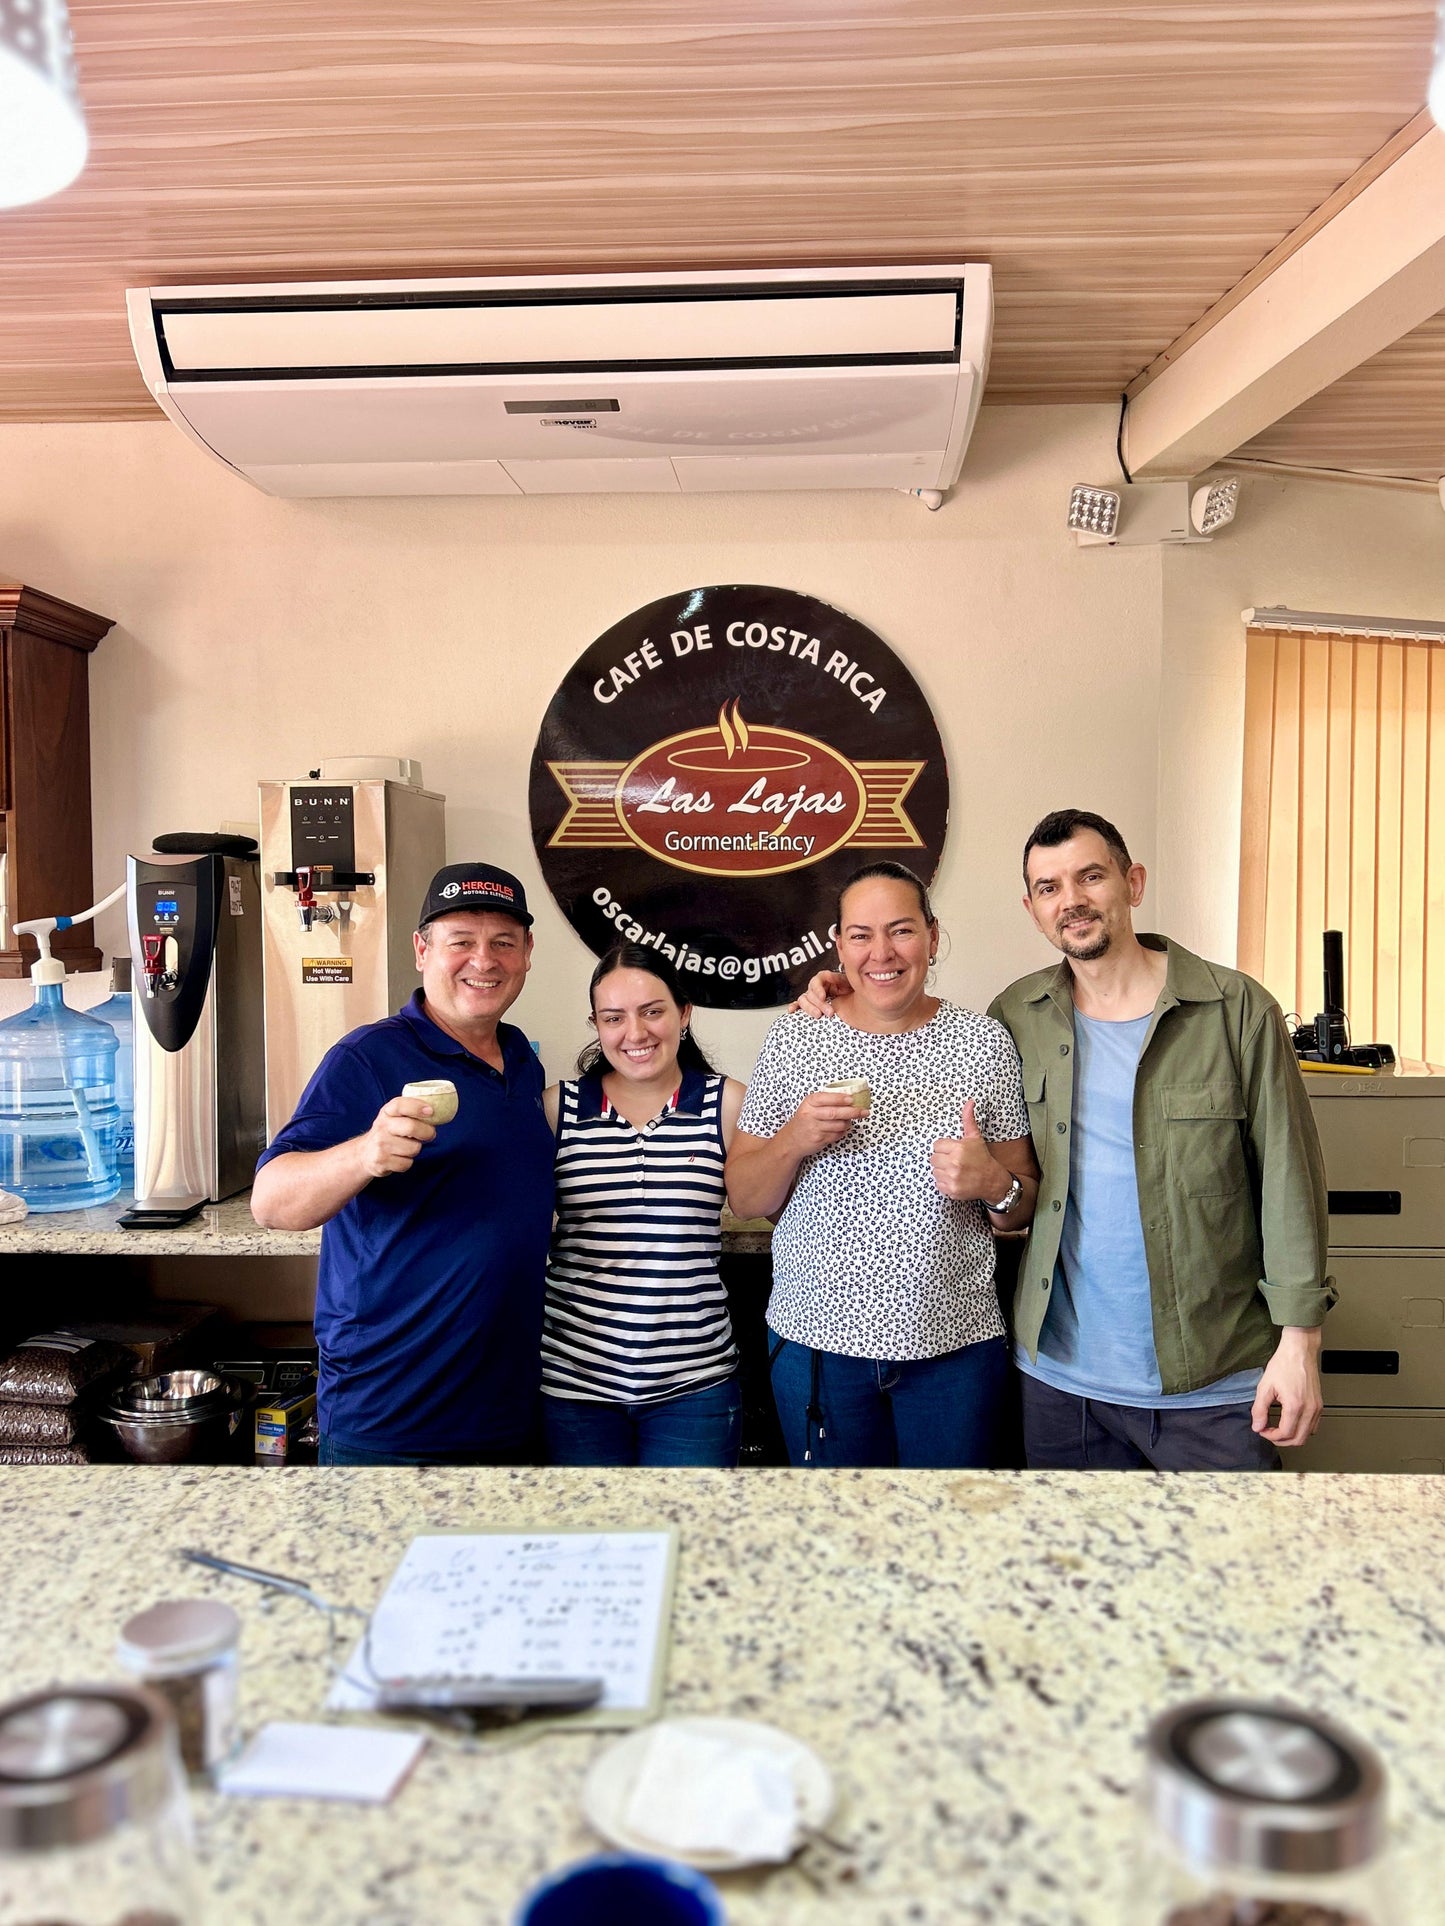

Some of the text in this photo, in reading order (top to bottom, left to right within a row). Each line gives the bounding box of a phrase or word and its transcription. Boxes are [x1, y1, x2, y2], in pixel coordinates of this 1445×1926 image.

[593, 621, 887, 714] CAFÉ DE COSTA RICA
[636, 776, 847, 824] Las Lajas
[664, 831, 815, 856] Gorment Fancy
[461, 881, 514, 898] HERCULES
[312, 967, 343, 975] Hot Water
